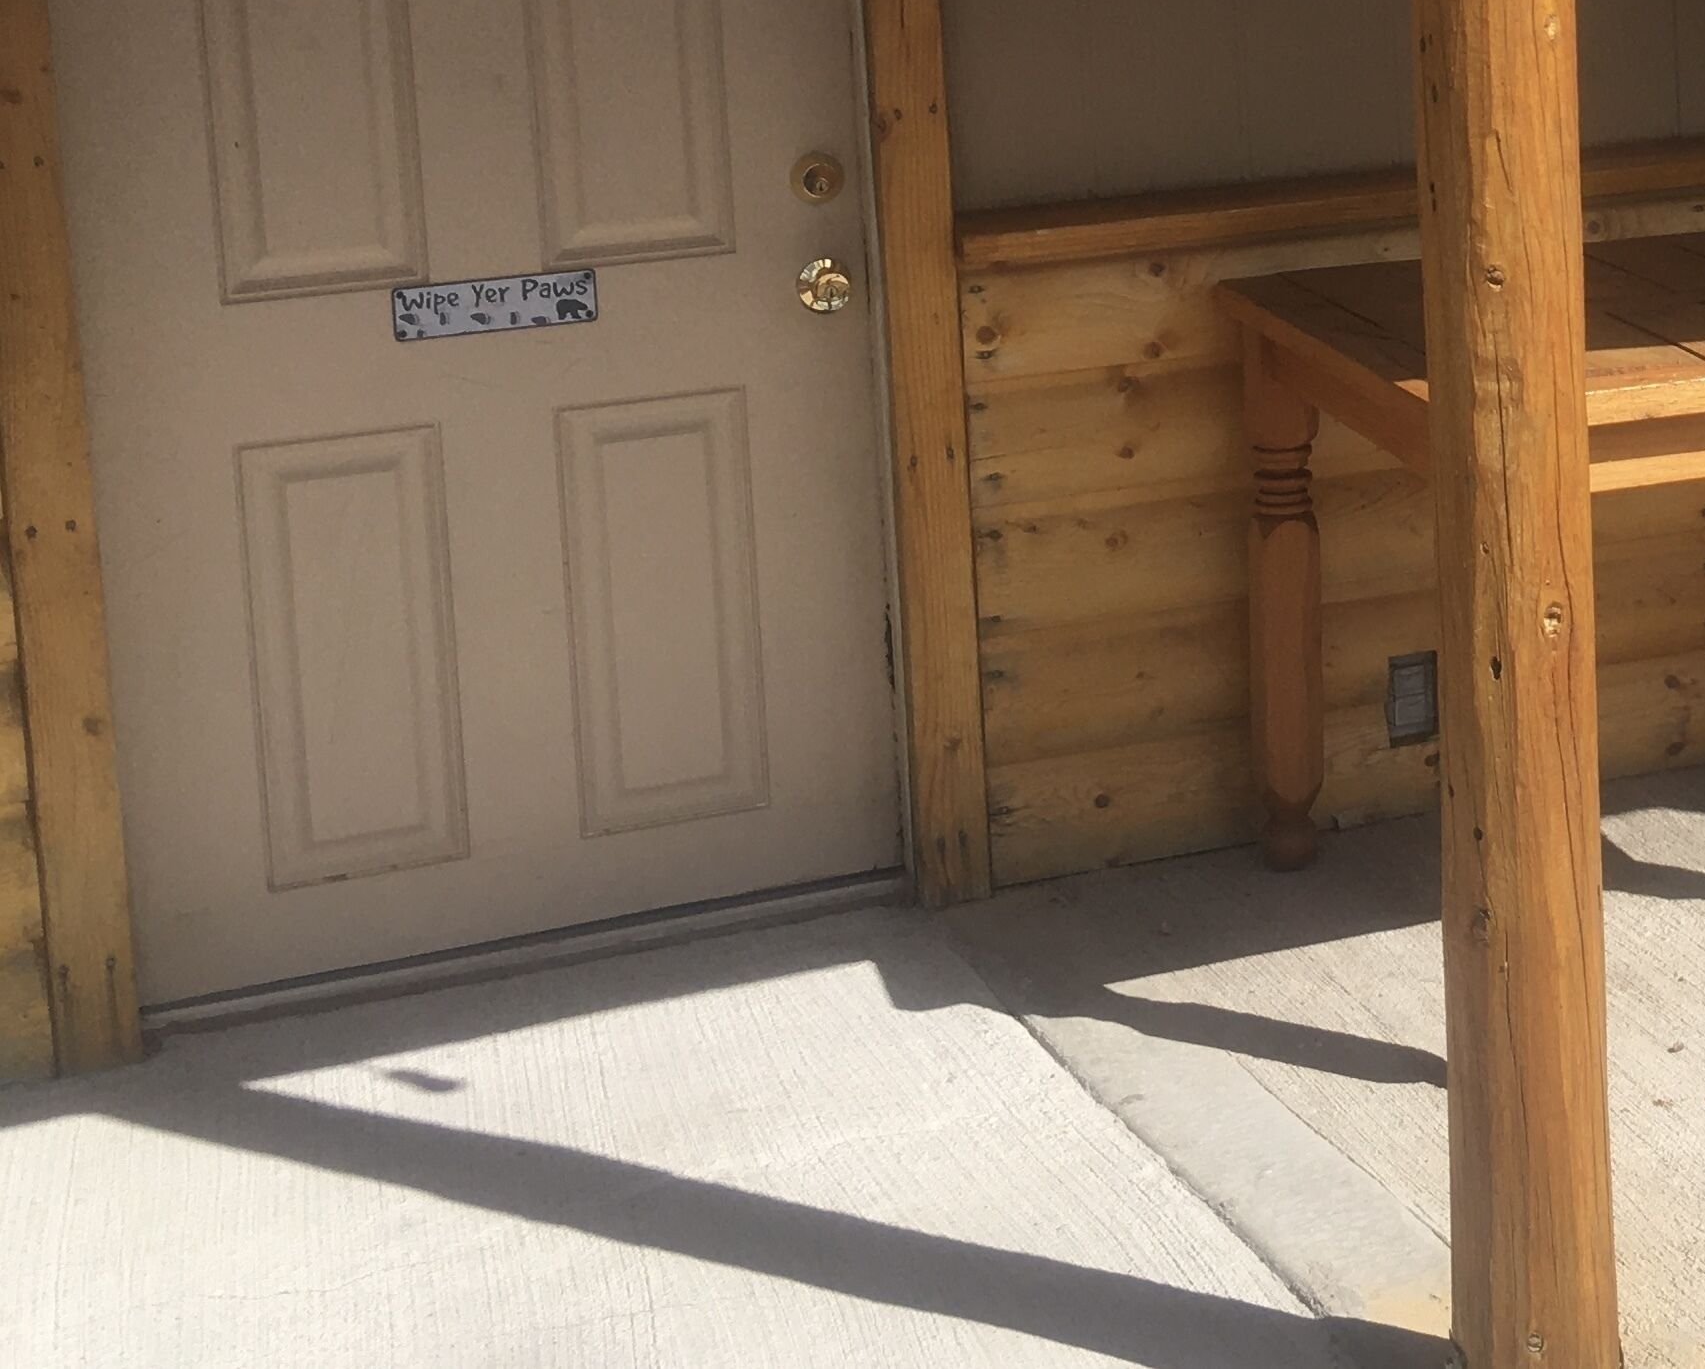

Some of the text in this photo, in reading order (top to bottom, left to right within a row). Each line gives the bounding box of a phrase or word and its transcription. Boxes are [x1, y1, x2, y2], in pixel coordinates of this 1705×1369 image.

[401, 278, 589, 315] Wipe Yer Paws
